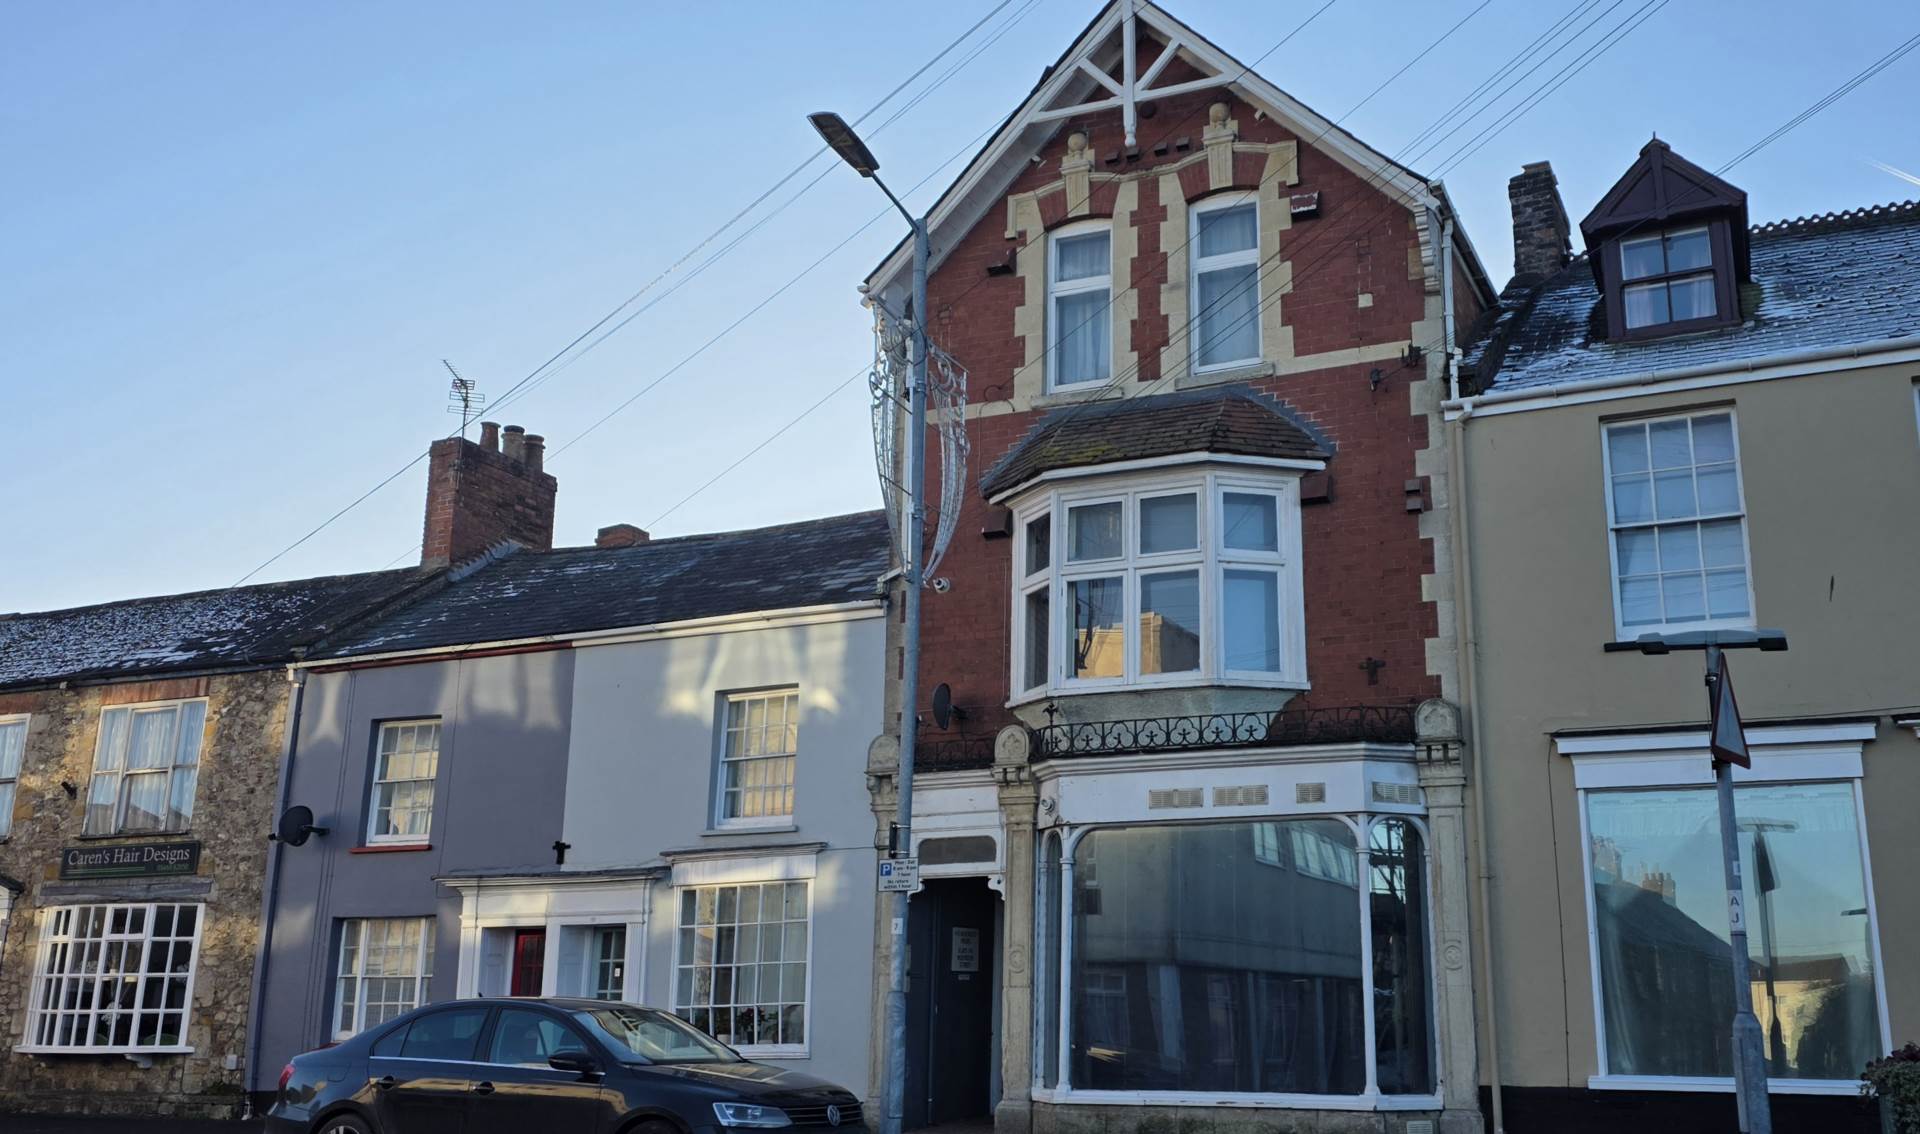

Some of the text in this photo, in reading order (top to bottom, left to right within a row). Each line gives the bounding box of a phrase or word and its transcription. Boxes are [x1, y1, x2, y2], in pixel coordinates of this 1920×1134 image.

[68, 845, 190, 866] Caren's Hair Designs
[883, 864, 890, 875] P
